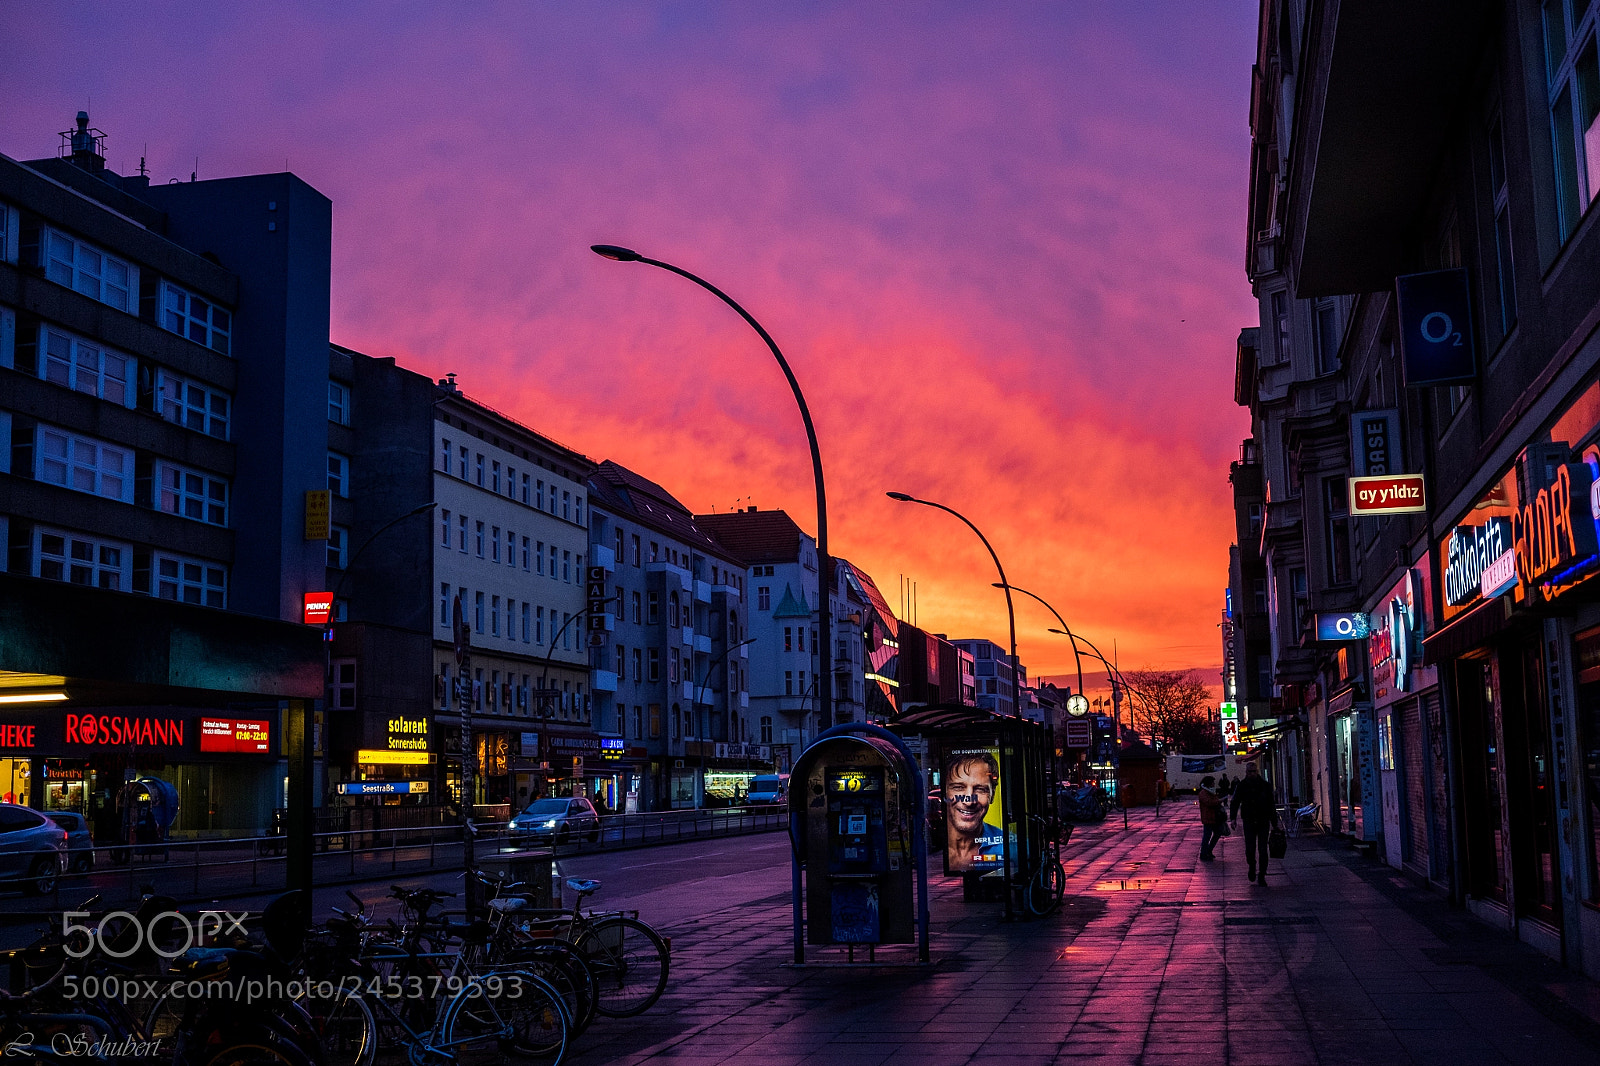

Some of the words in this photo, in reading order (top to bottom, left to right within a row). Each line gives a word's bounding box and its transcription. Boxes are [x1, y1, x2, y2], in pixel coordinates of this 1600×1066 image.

[1368, 423, 1386, 475] BASE
[1359, 489, 1377, 504] ay
[590, 568, 601, 629] CAFE
[66, 714, 183, 746] ROSSMANN
[388, 716, 427, 734] solarent
[388, 737, 427, 749] Sonnenstudio
[337, 784, 345, 794] U
[362, 784, 395, 792] Seestraße
[955, 794, 978, 803] Wall
